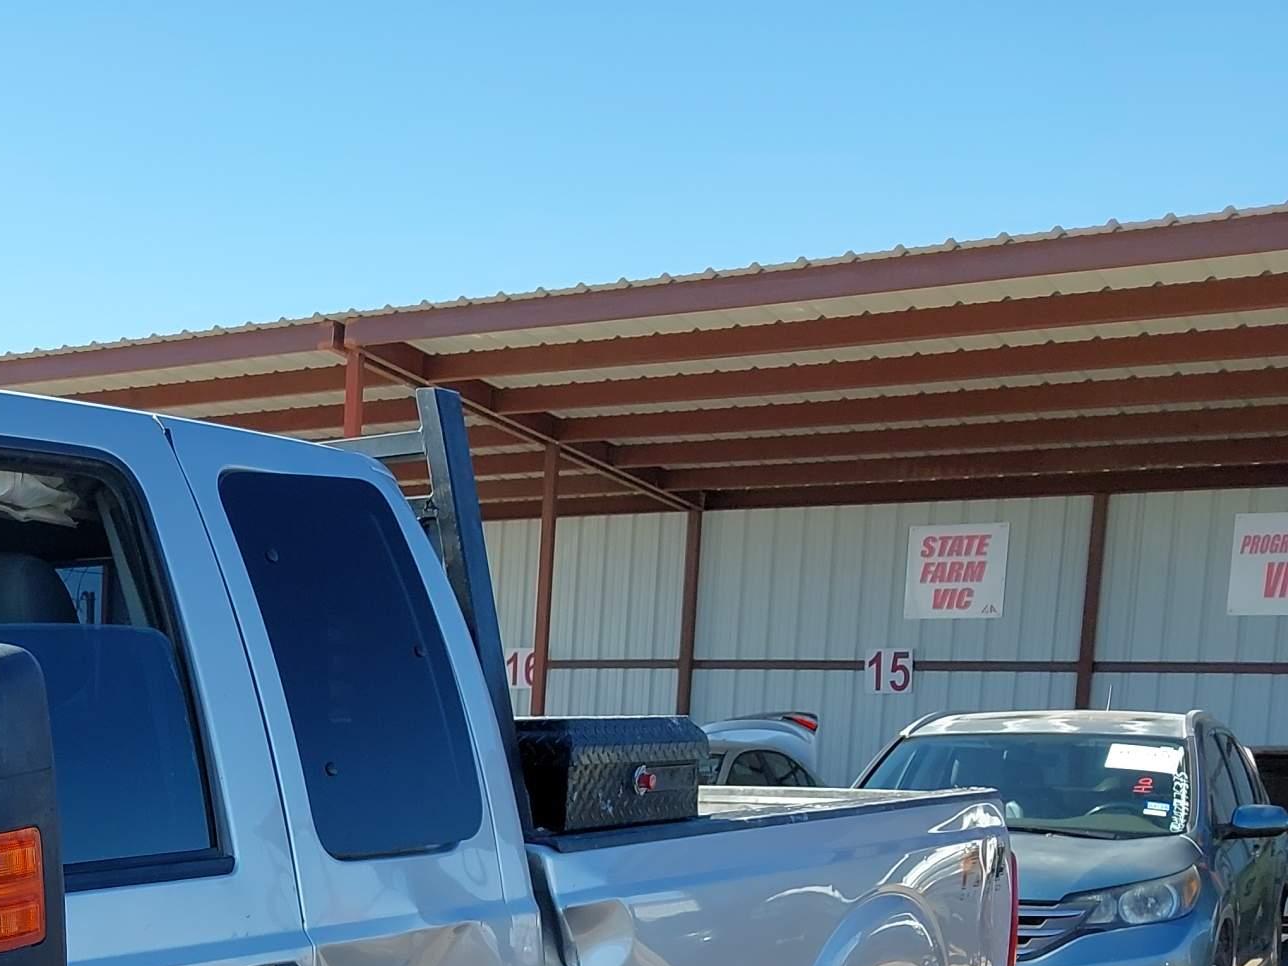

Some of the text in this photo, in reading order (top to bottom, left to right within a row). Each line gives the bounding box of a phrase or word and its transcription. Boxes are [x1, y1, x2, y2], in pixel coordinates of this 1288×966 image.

[920, 534, 992, 558] STATE
[919, 561, 987, 584] FARM
[931, 588, 974, 611] VIC
[868, 651, 910, 692] 15
